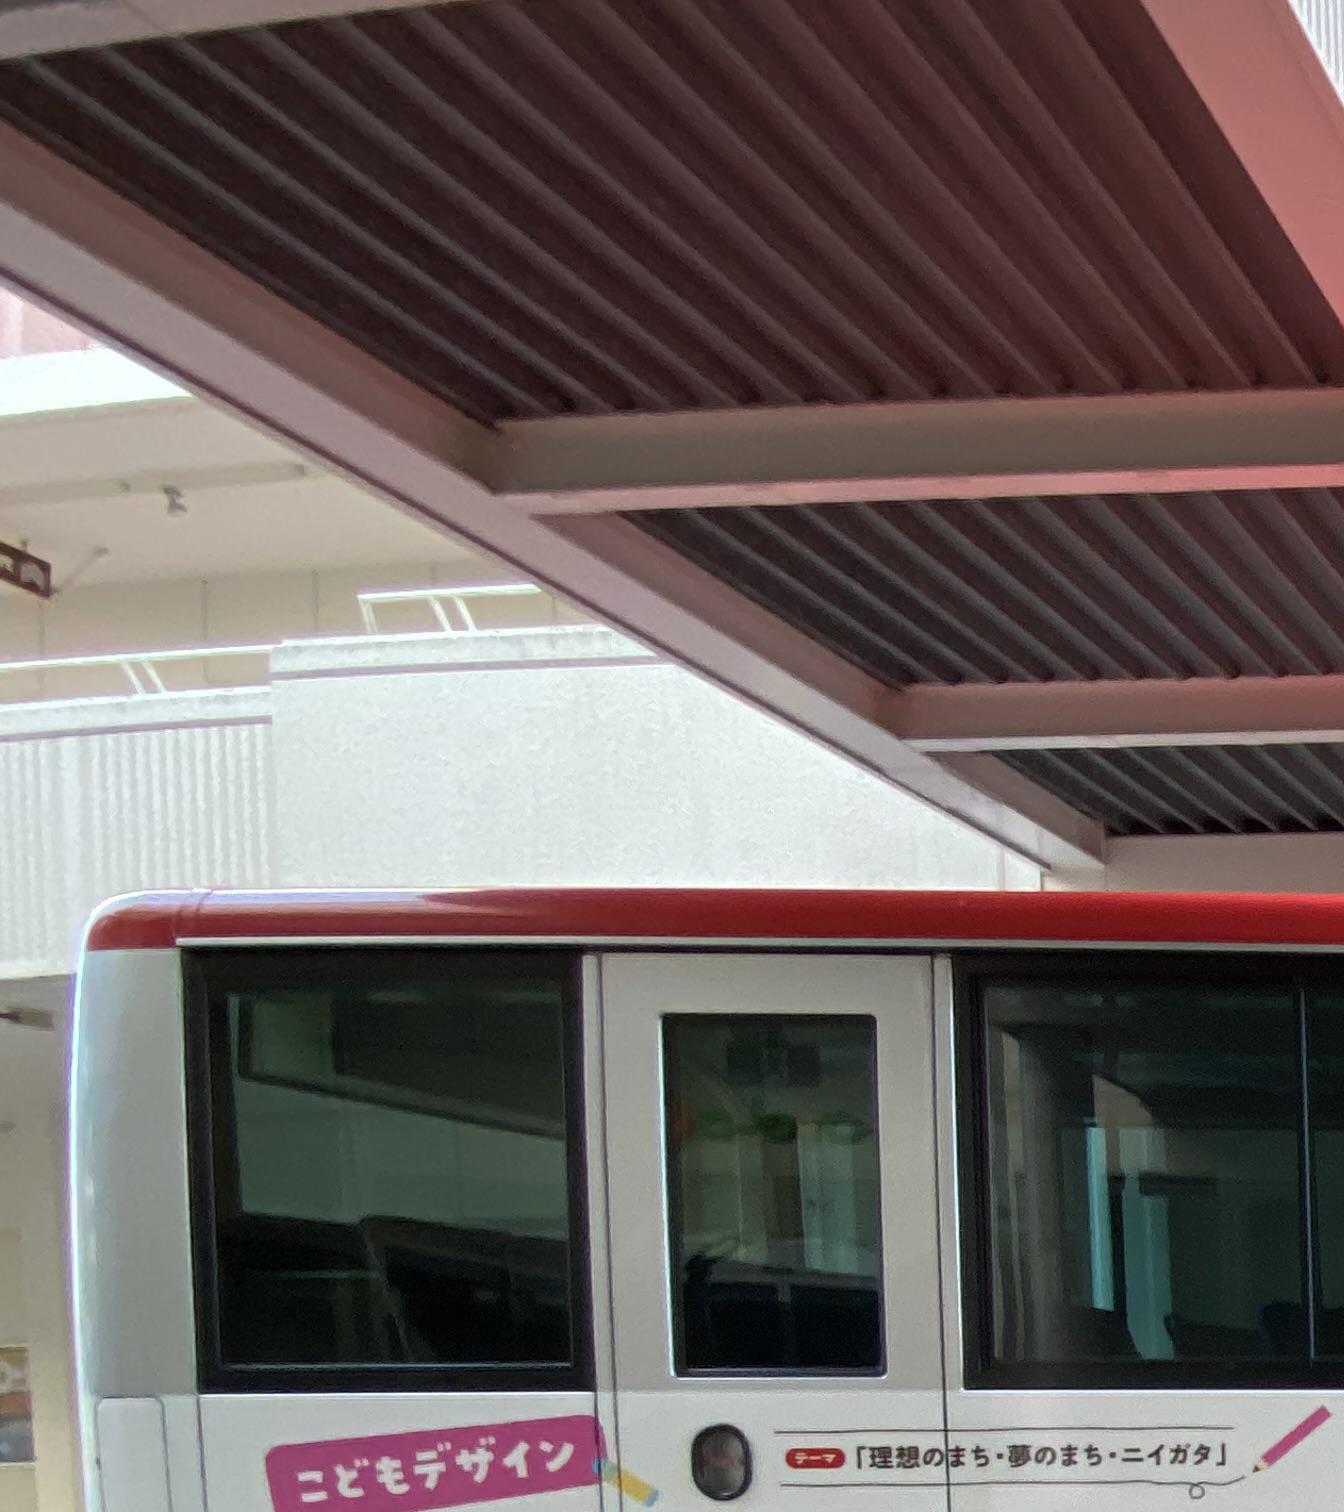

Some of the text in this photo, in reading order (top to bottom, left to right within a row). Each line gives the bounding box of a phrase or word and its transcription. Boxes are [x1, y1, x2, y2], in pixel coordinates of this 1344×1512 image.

[297, 1436, 575, 1503] こどもデザイン
[793, 1451, 837, 1465] テーマ
